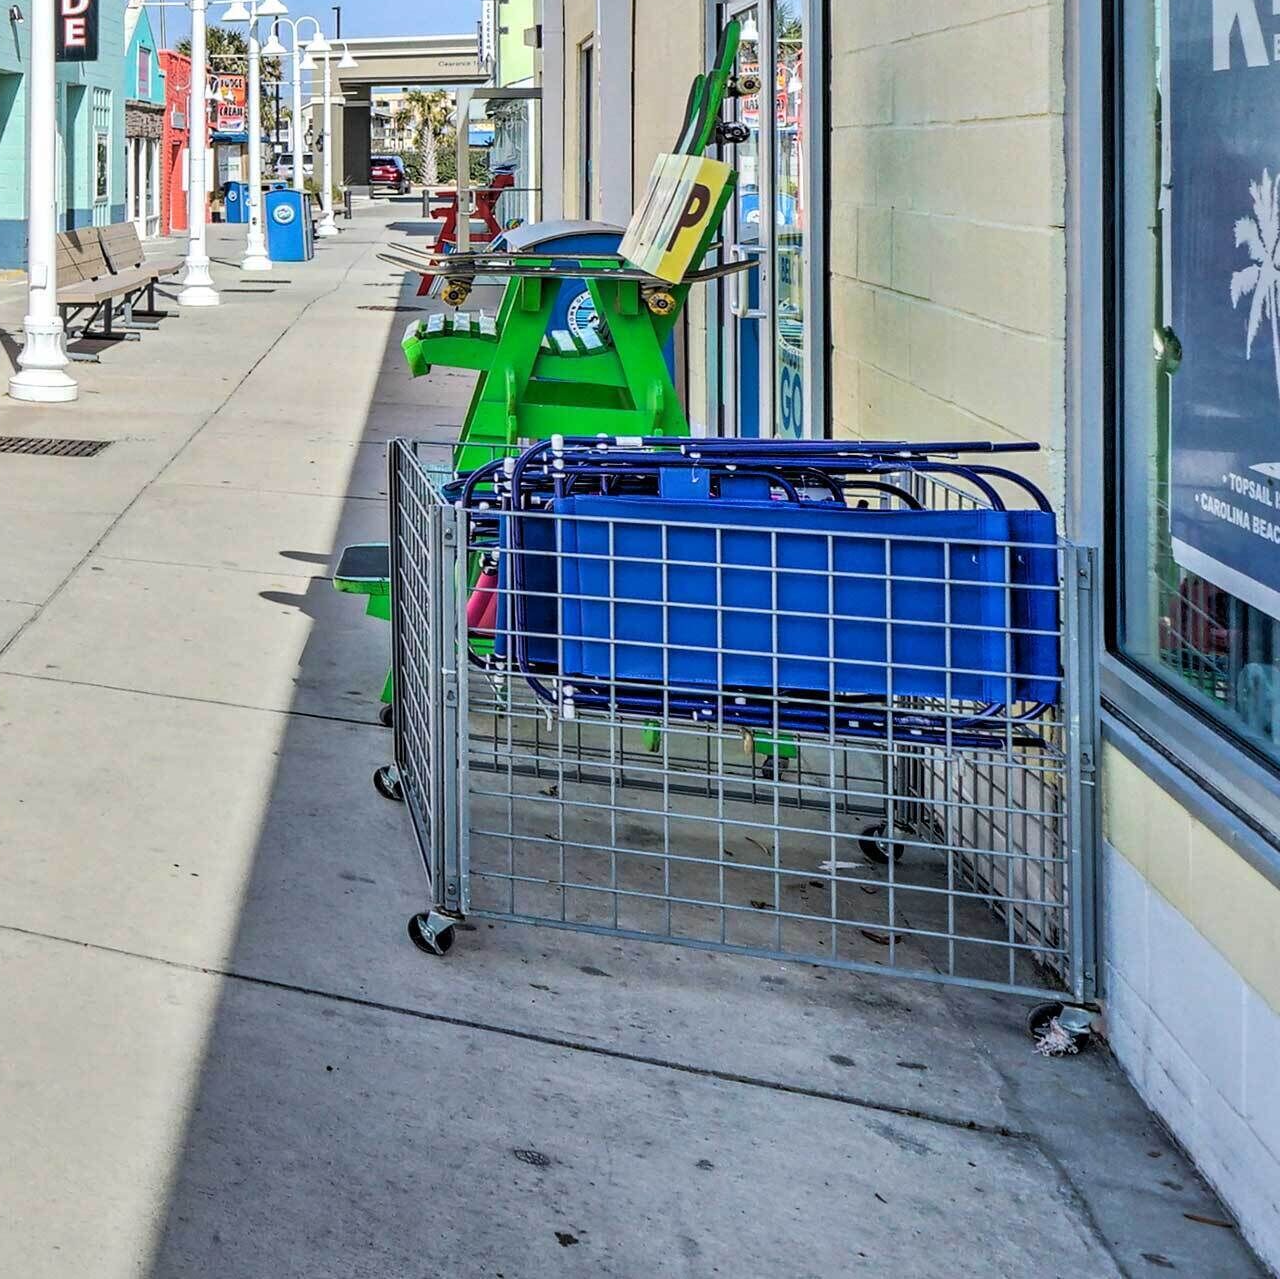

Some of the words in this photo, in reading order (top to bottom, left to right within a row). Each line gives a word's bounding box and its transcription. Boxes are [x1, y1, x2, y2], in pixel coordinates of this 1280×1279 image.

[665, 182, 711, 253] P
[780, 365, 804, 438] GO
[1200, 492, 1251, 531] CAROLINA
[1229, 471, 1273, 507] TOPSAIL
